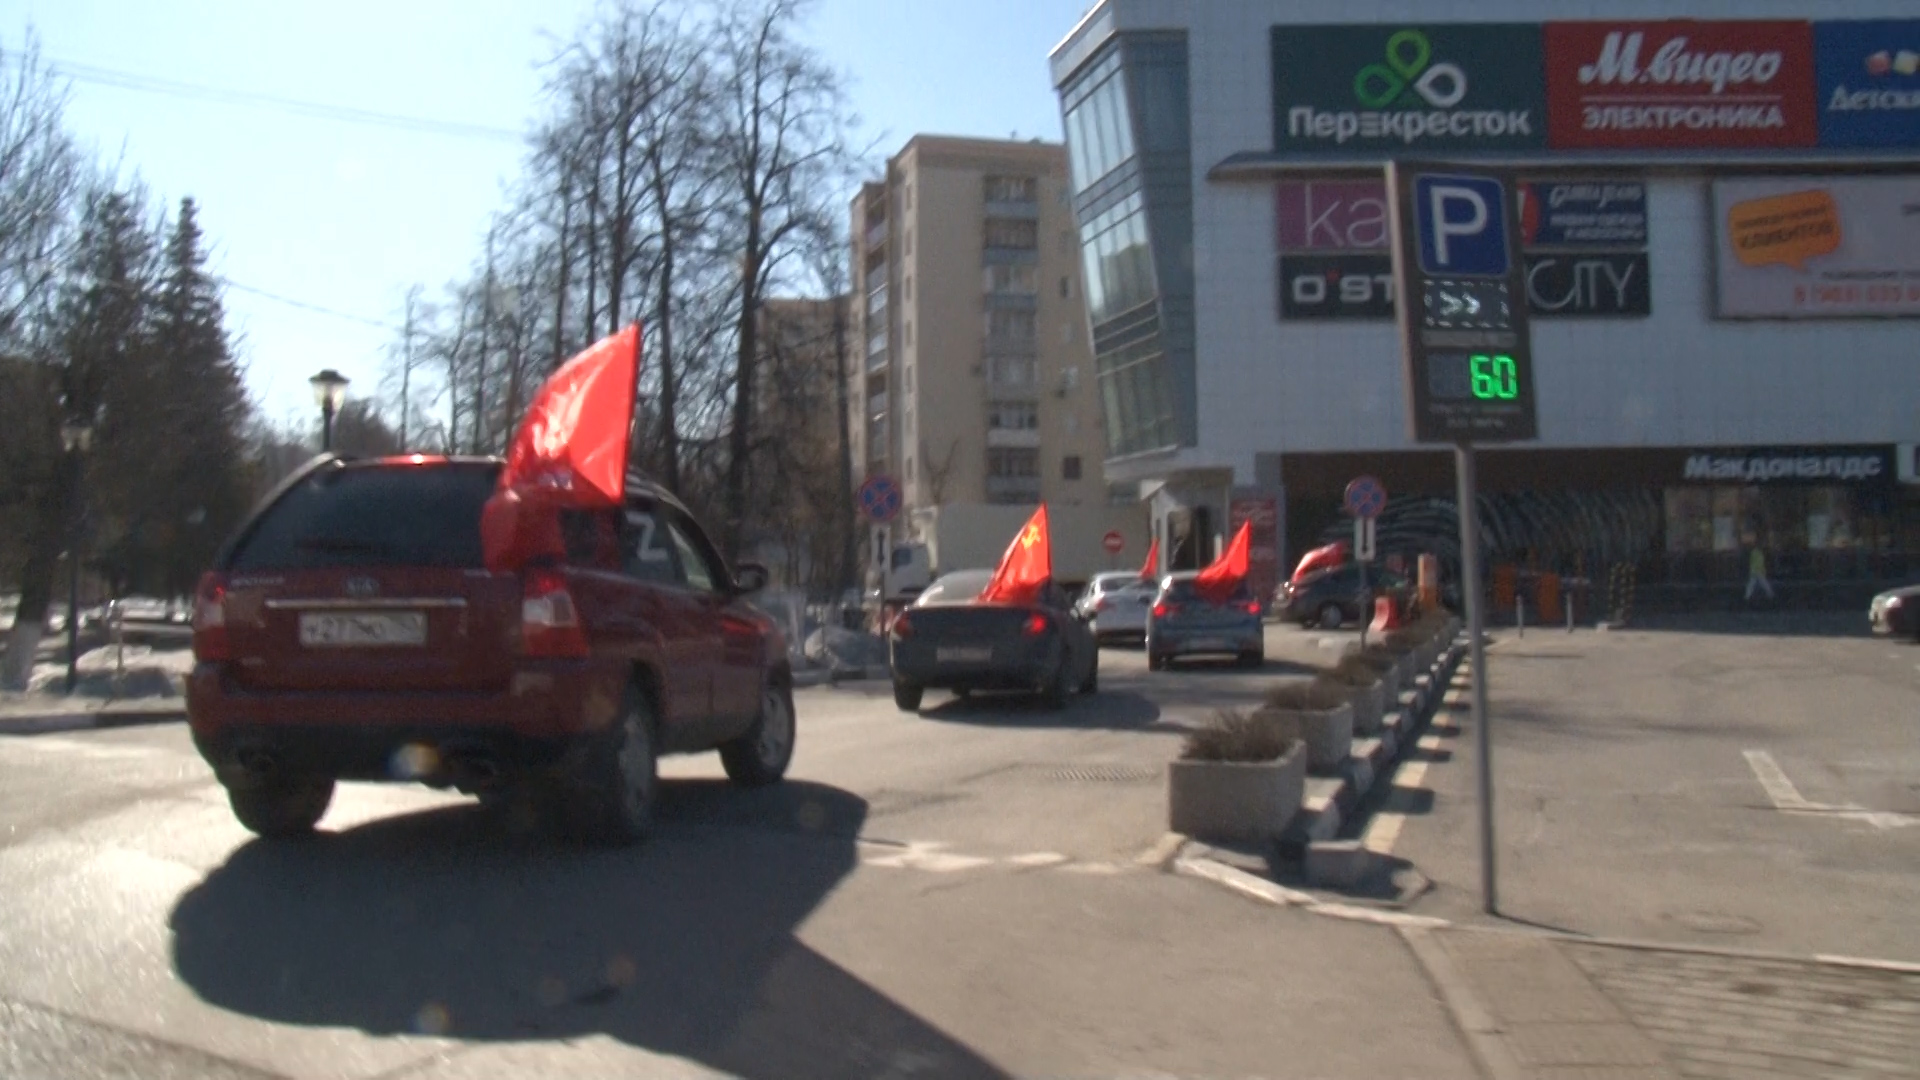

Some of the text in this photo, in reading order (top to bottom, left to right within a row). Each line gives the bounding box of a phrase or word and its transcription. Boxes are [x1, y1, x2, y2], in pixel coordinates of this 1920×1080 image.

[1579, 32, 1783, 91] М.видео
[1289, 106, 1532, 143] Перекресток
[1583, 104, 1784, 131] ЭЛЕКТРОНИКА
[1304, 181, 1389, 248] ka
[1430, 186, 1488, 265] P
[1292, 268, 1395, 303] O'ST
[1525, 258, 1635, 310] CITY
[1469, 354, 1518, 399] 60
[1684, 455, 1882, 480] Макдоналдс
